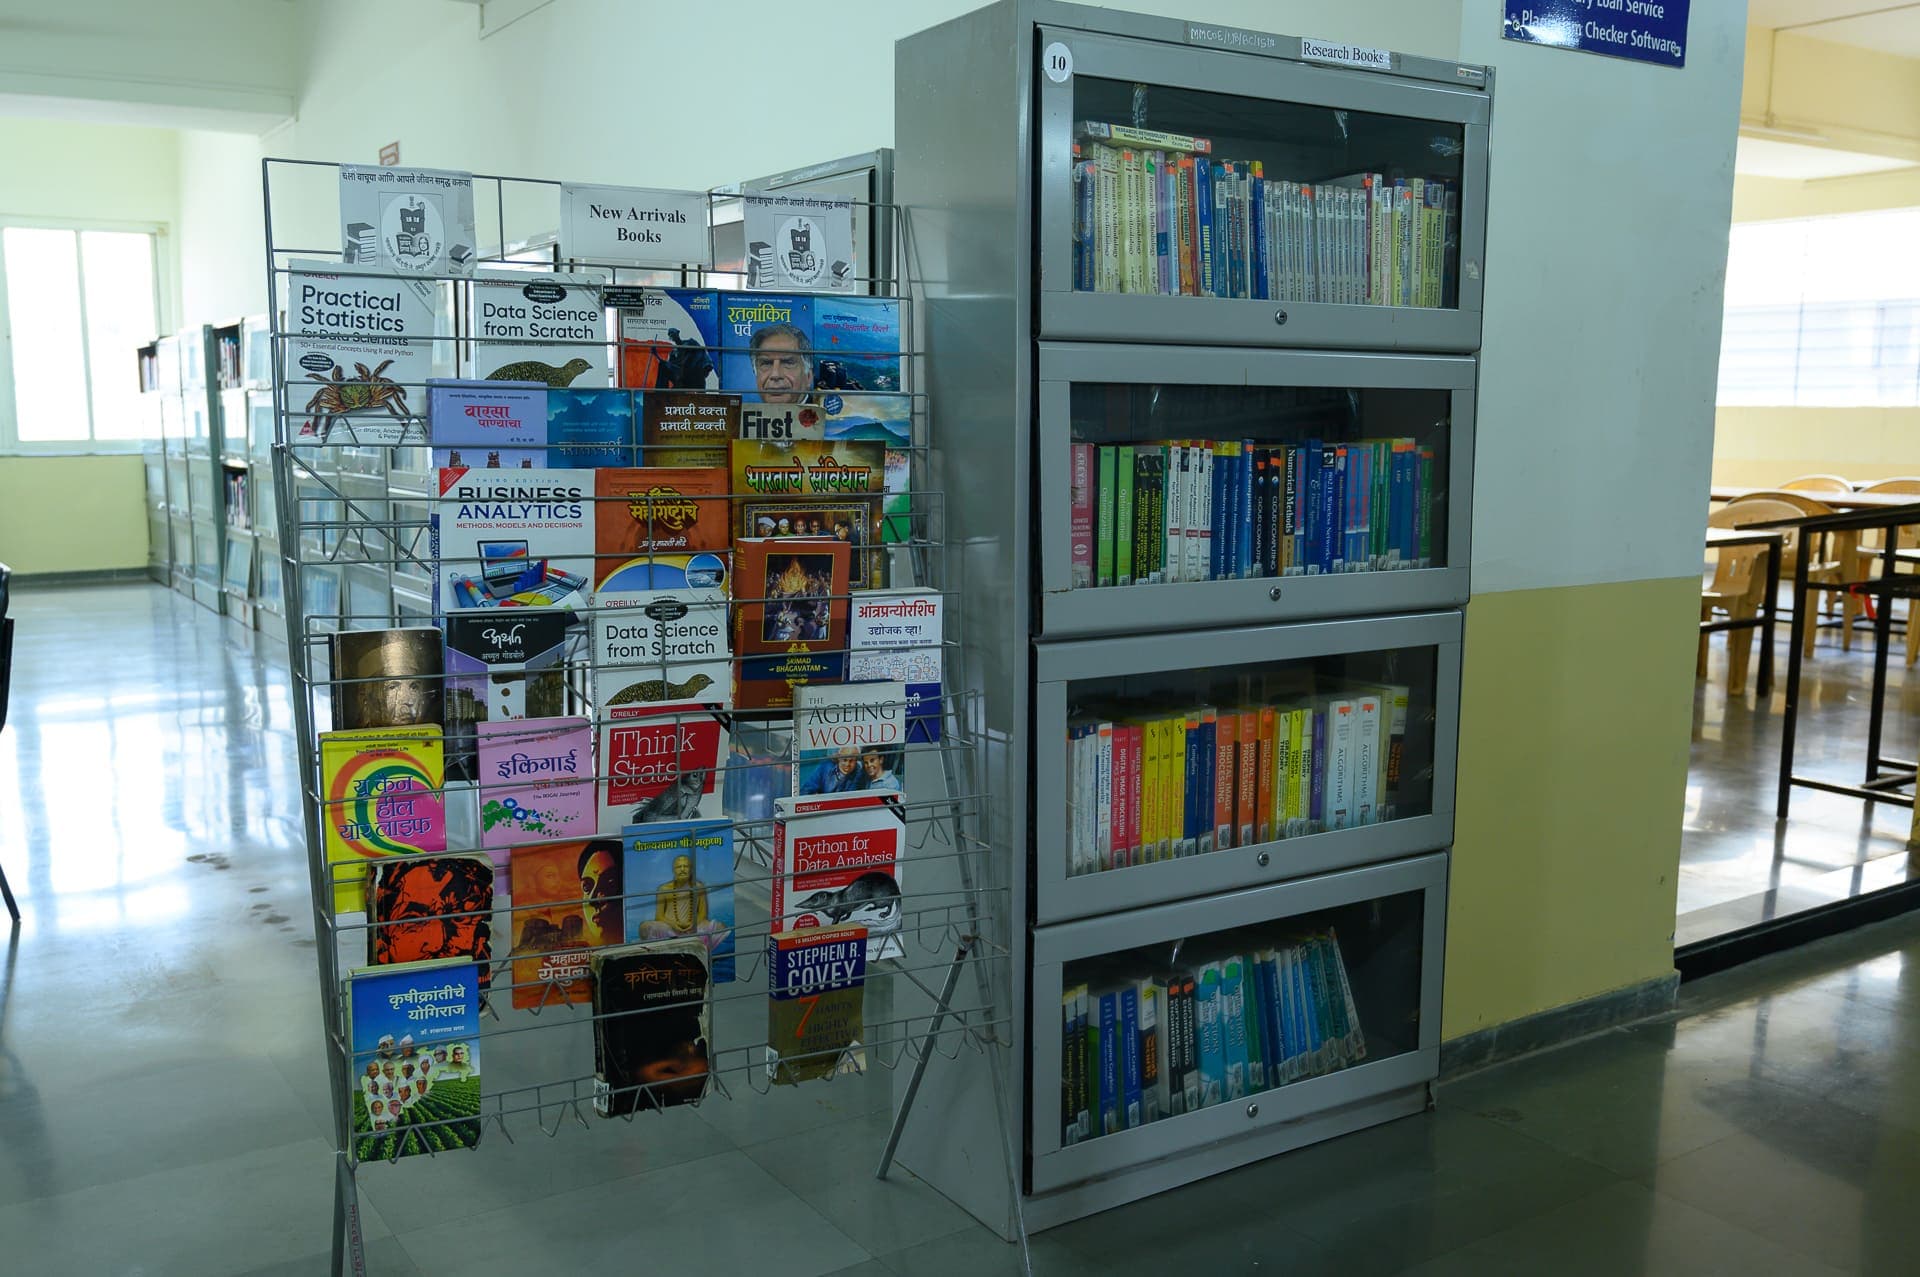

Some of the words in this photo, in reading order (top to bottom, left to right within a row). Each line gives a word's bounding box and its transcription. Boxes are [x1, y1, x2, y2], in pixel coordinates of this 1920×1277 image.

[1626, 0, 1664, 19] Service
[1585, 21, 1628, 45] Checker
[1630, 29, 1677, 53] Software
[1050, 53, 1066, 71] 10
[1303, 41, 1349, 61] Research
[1352, 47, 1385, 64] Books
[379, 172, 395, 182] आणि
[396, 173, 415, 184] आपले
[589, 204, 623, 221] New
[626, 207, 687, 225] Arrivals
[616, 226, 662, 244] Books
[302, 284, 401, 312] Practical
[301, 305, 404, 333] Statistics
[483, 302, 526, 319] Data
[531, 304, 598, 322] Science
[483, 321, 524, 337] from
[529, 322, 594, 339] Scratch
[337, 344, 362, 354] Concepts
[394, 349, 414, 357] Python
[464, 405, 510, 419] वारसा
[664, 402, 696, 416] प्रभावी
[660, 418, 691, 431] प्रभावी
[742, 411, 793, 439] First
[745, 455, 805, 493] भारताचे
[807, 454, 872, 493] संविधान
[1286, 449, 1295, 494] Numerical
[458, 486, 582, 503] BUSINESS
[457, 504, 582, 519] ANALYTICS
[1285, 496, 1294, 534] Methods
[606, 624, 648, 640] Data
[654, 622, 719, 638] Science
[867, 623, 902, 637] उद्योजक
[606, 643, 646, 658] from
[651, 639, 715, 656] Scratch
[808, 697, 824, 705] THE
[808, 700, 897, 725] AGEING
[611, 710, 640, 718] O'REILLY
[614, 726, 697, 758] Think
[808, 722, 897, 748] WORLD
[496, 748, 578, 779] इकिगाई
[613, 759, 679, 788] Stats
[1217, 745, 1226, 804] PROCESSING
[1225, 745, 1233, 780] DIGITAL
[1241, 743, 1249, 801] PROCESSING
[1360, 743, 1369, 799] ALGORITHMS
[1336, 748, 1345, 804] ALGORITHMS
[1224, 783, 1232, 813] IMAGE
[338, 818, 373, 842] योर
[374, 817, 432, 839] लाइफ
[798, 839, 849, 859] Python
[852, 835, 870, 851] for
[798, 857, 830, 874] Data
[835, 850, 893, 869] Analysis
[801, 935, 822, 943] MILLION
[787, 942, 846, 969] STEPHEN
[849, 942, 861, 958] R.
[787, 959, 857, 996] COVEY
[388, 983, 466, 1010] कृषीक्रांतीचे
[408, 1003, 466, 1021] योगिराज
[797, 995, 821, 1038] 7
